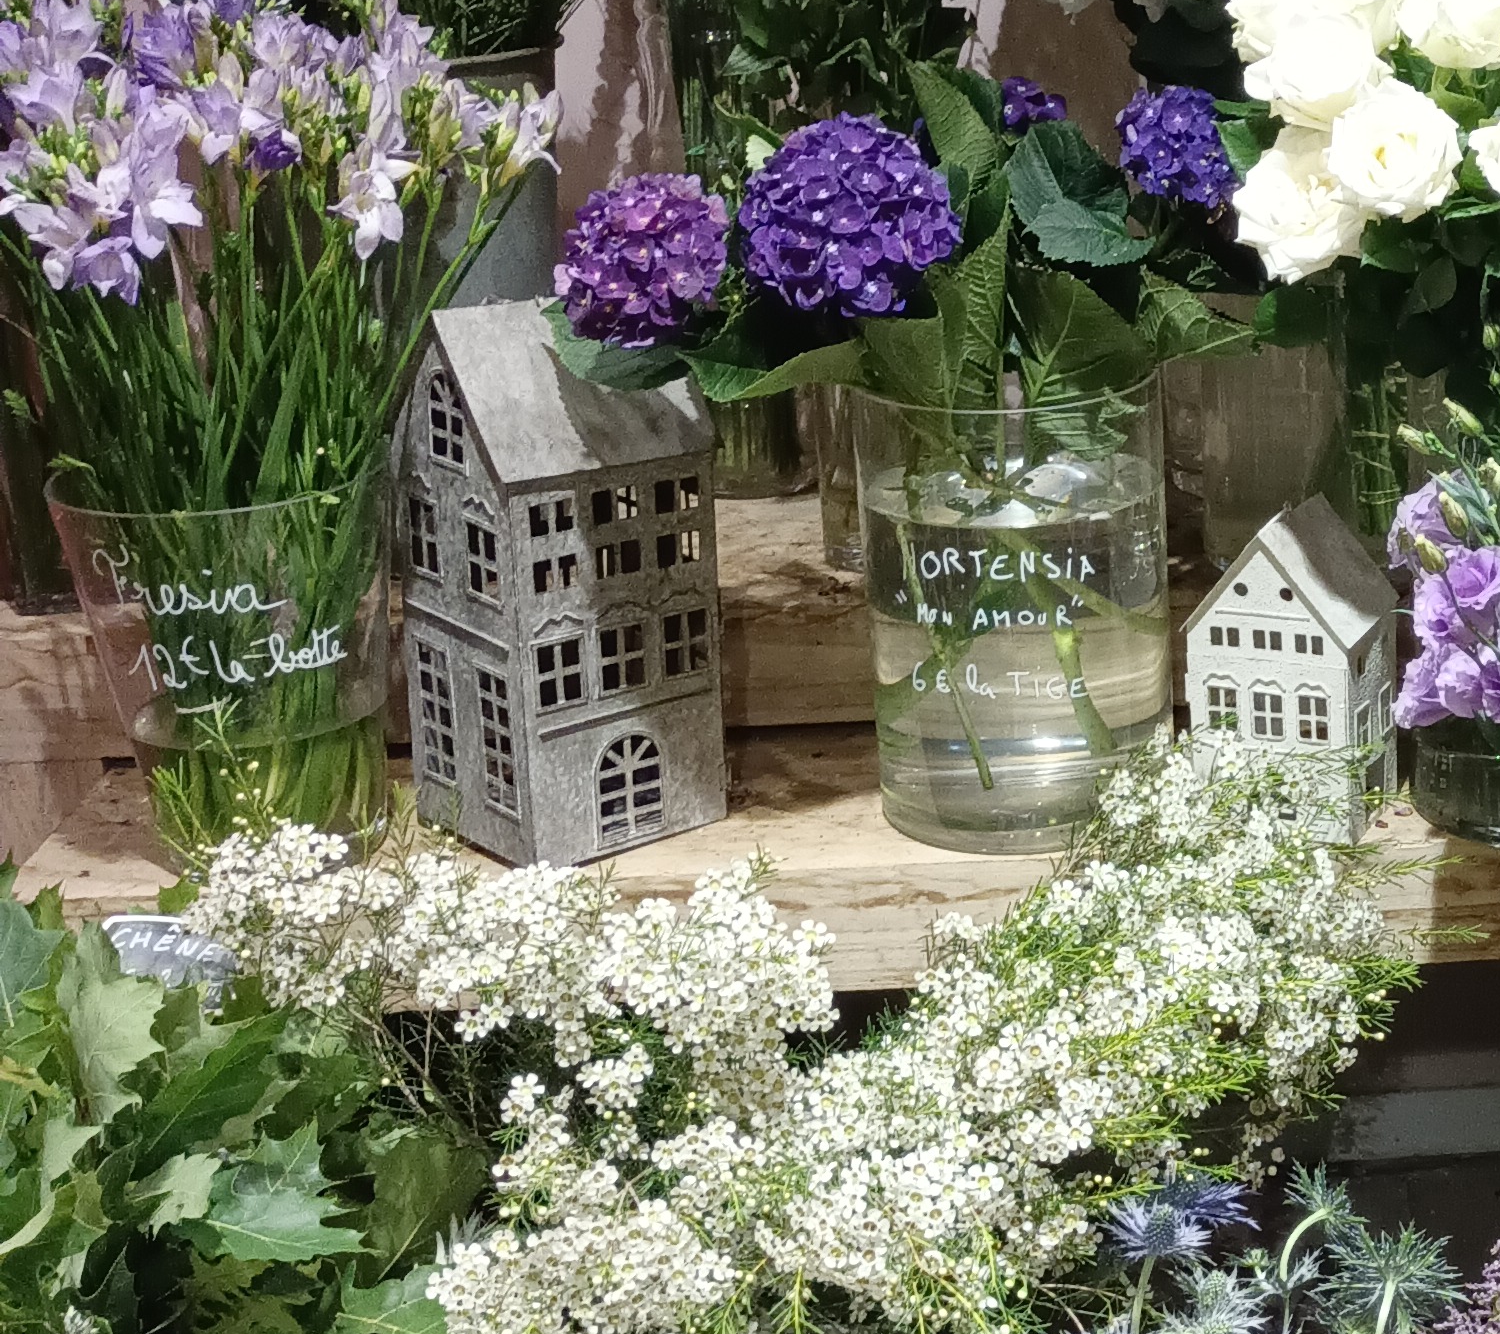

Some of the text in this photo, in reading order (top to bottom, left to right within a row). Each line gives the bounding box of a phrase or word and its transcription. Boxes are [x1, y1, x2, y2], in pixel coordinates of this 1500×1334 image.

[128, 624, 348, 691] 12€ la botte
[965, 663, 997, 699] la
